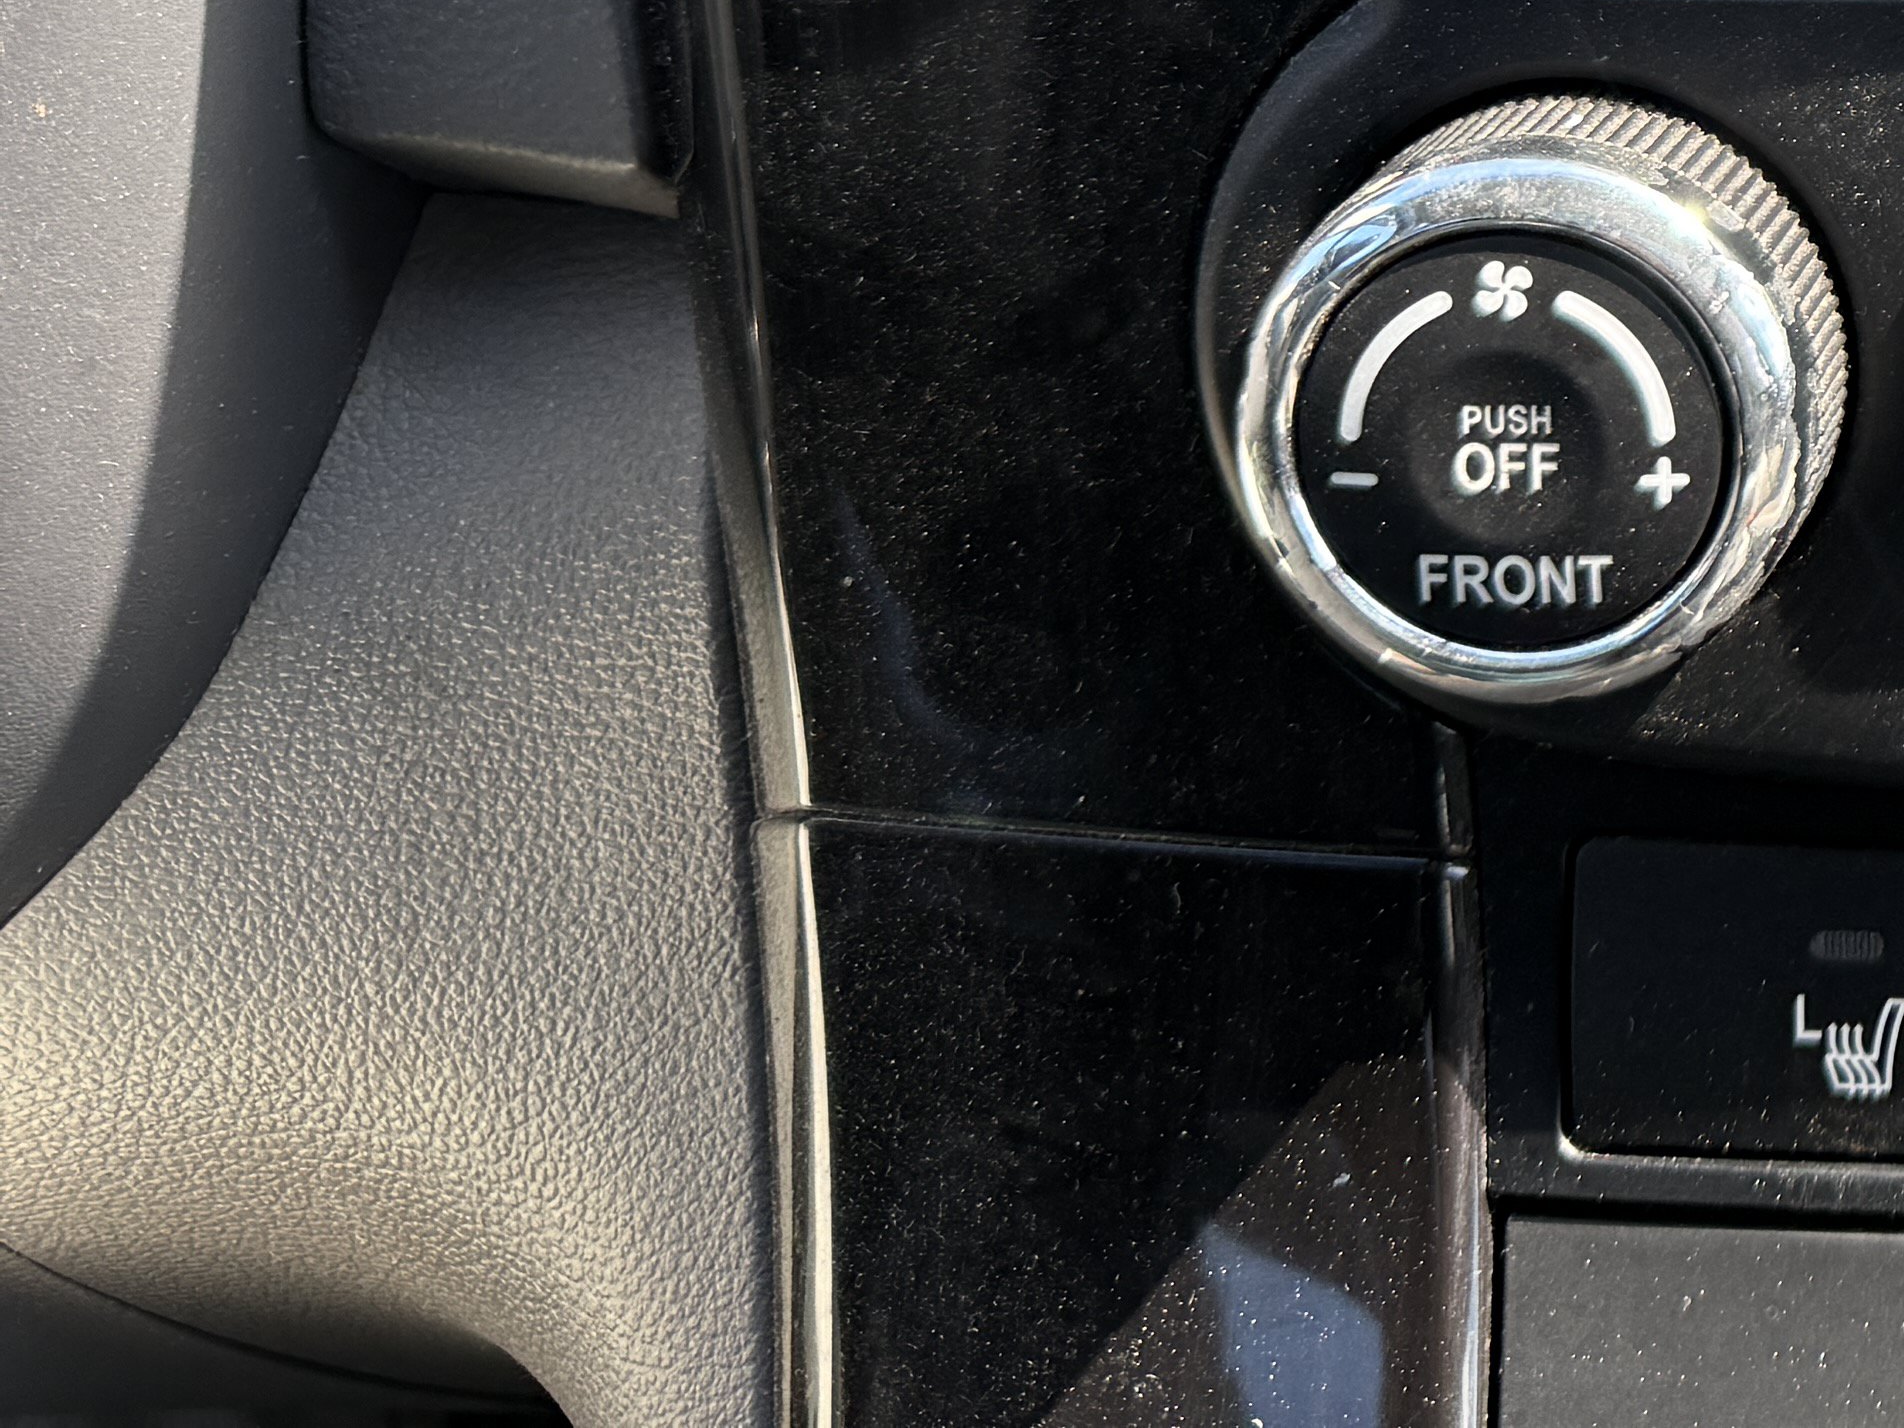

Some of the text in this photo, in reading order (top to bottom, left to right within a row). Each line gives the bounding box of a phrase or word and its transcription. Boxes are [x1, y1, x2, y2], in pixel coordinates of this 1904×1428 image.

[1459, 405, 1552, 437] PUSH
[1452, 442, 1561, 496] OFF
[1415, 553, 1614, 608] FRONT
[1793, 994, 1823, 1046] L
